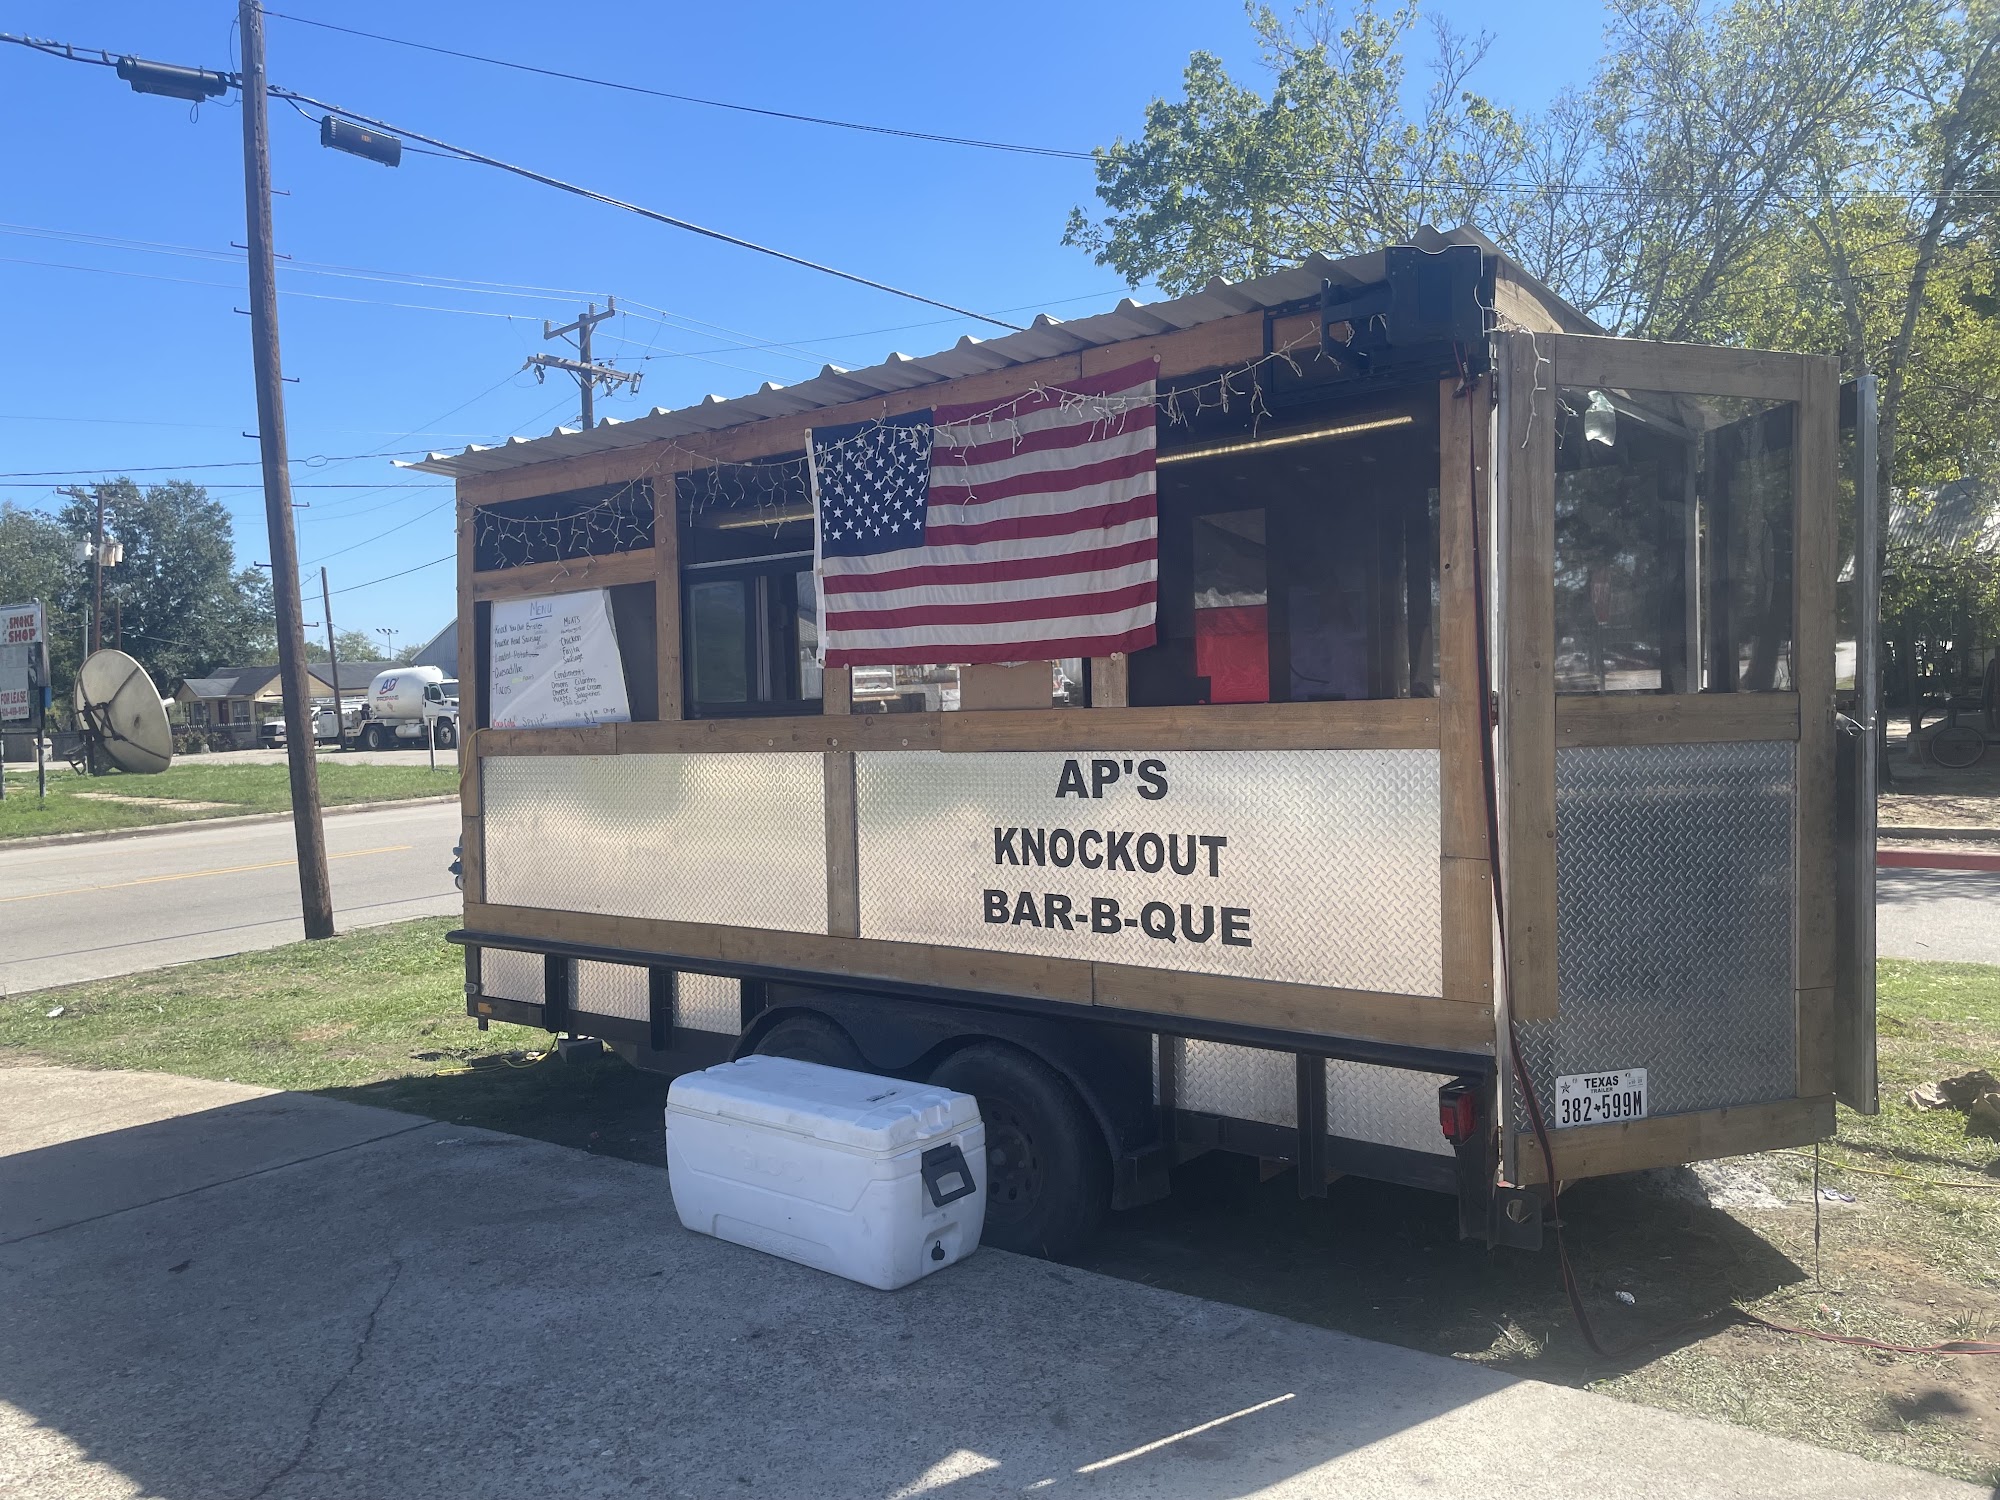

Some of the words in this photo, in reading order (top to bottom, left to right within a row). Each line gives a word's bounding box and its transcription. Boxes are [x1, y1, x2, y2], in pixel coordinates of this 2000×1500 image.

[10, 614, 34, 629] SMOKE
[8, 628, 36, 642] SHOP
[522, 634, 542, 645] Sausage
[560, 634, 582, 646] Chicken
[562, 654, 584, 665] Sausage
[554, 669, 586, 680] Condiments
[574, 677, 597, 686] Cilantro
[1, 692, 10, 705] FOR
[10, 690, 26, 704] LEASE
[552, 688, 569, 696] Cheese
[1055, 759, 1169, 800] AP'S
[994, 827, 1227, 878] KNOCKOUT
[983, 888, 1253, 948] BAR-B-QUE
[1584, 1075, 1619, 1089] TEXAS
